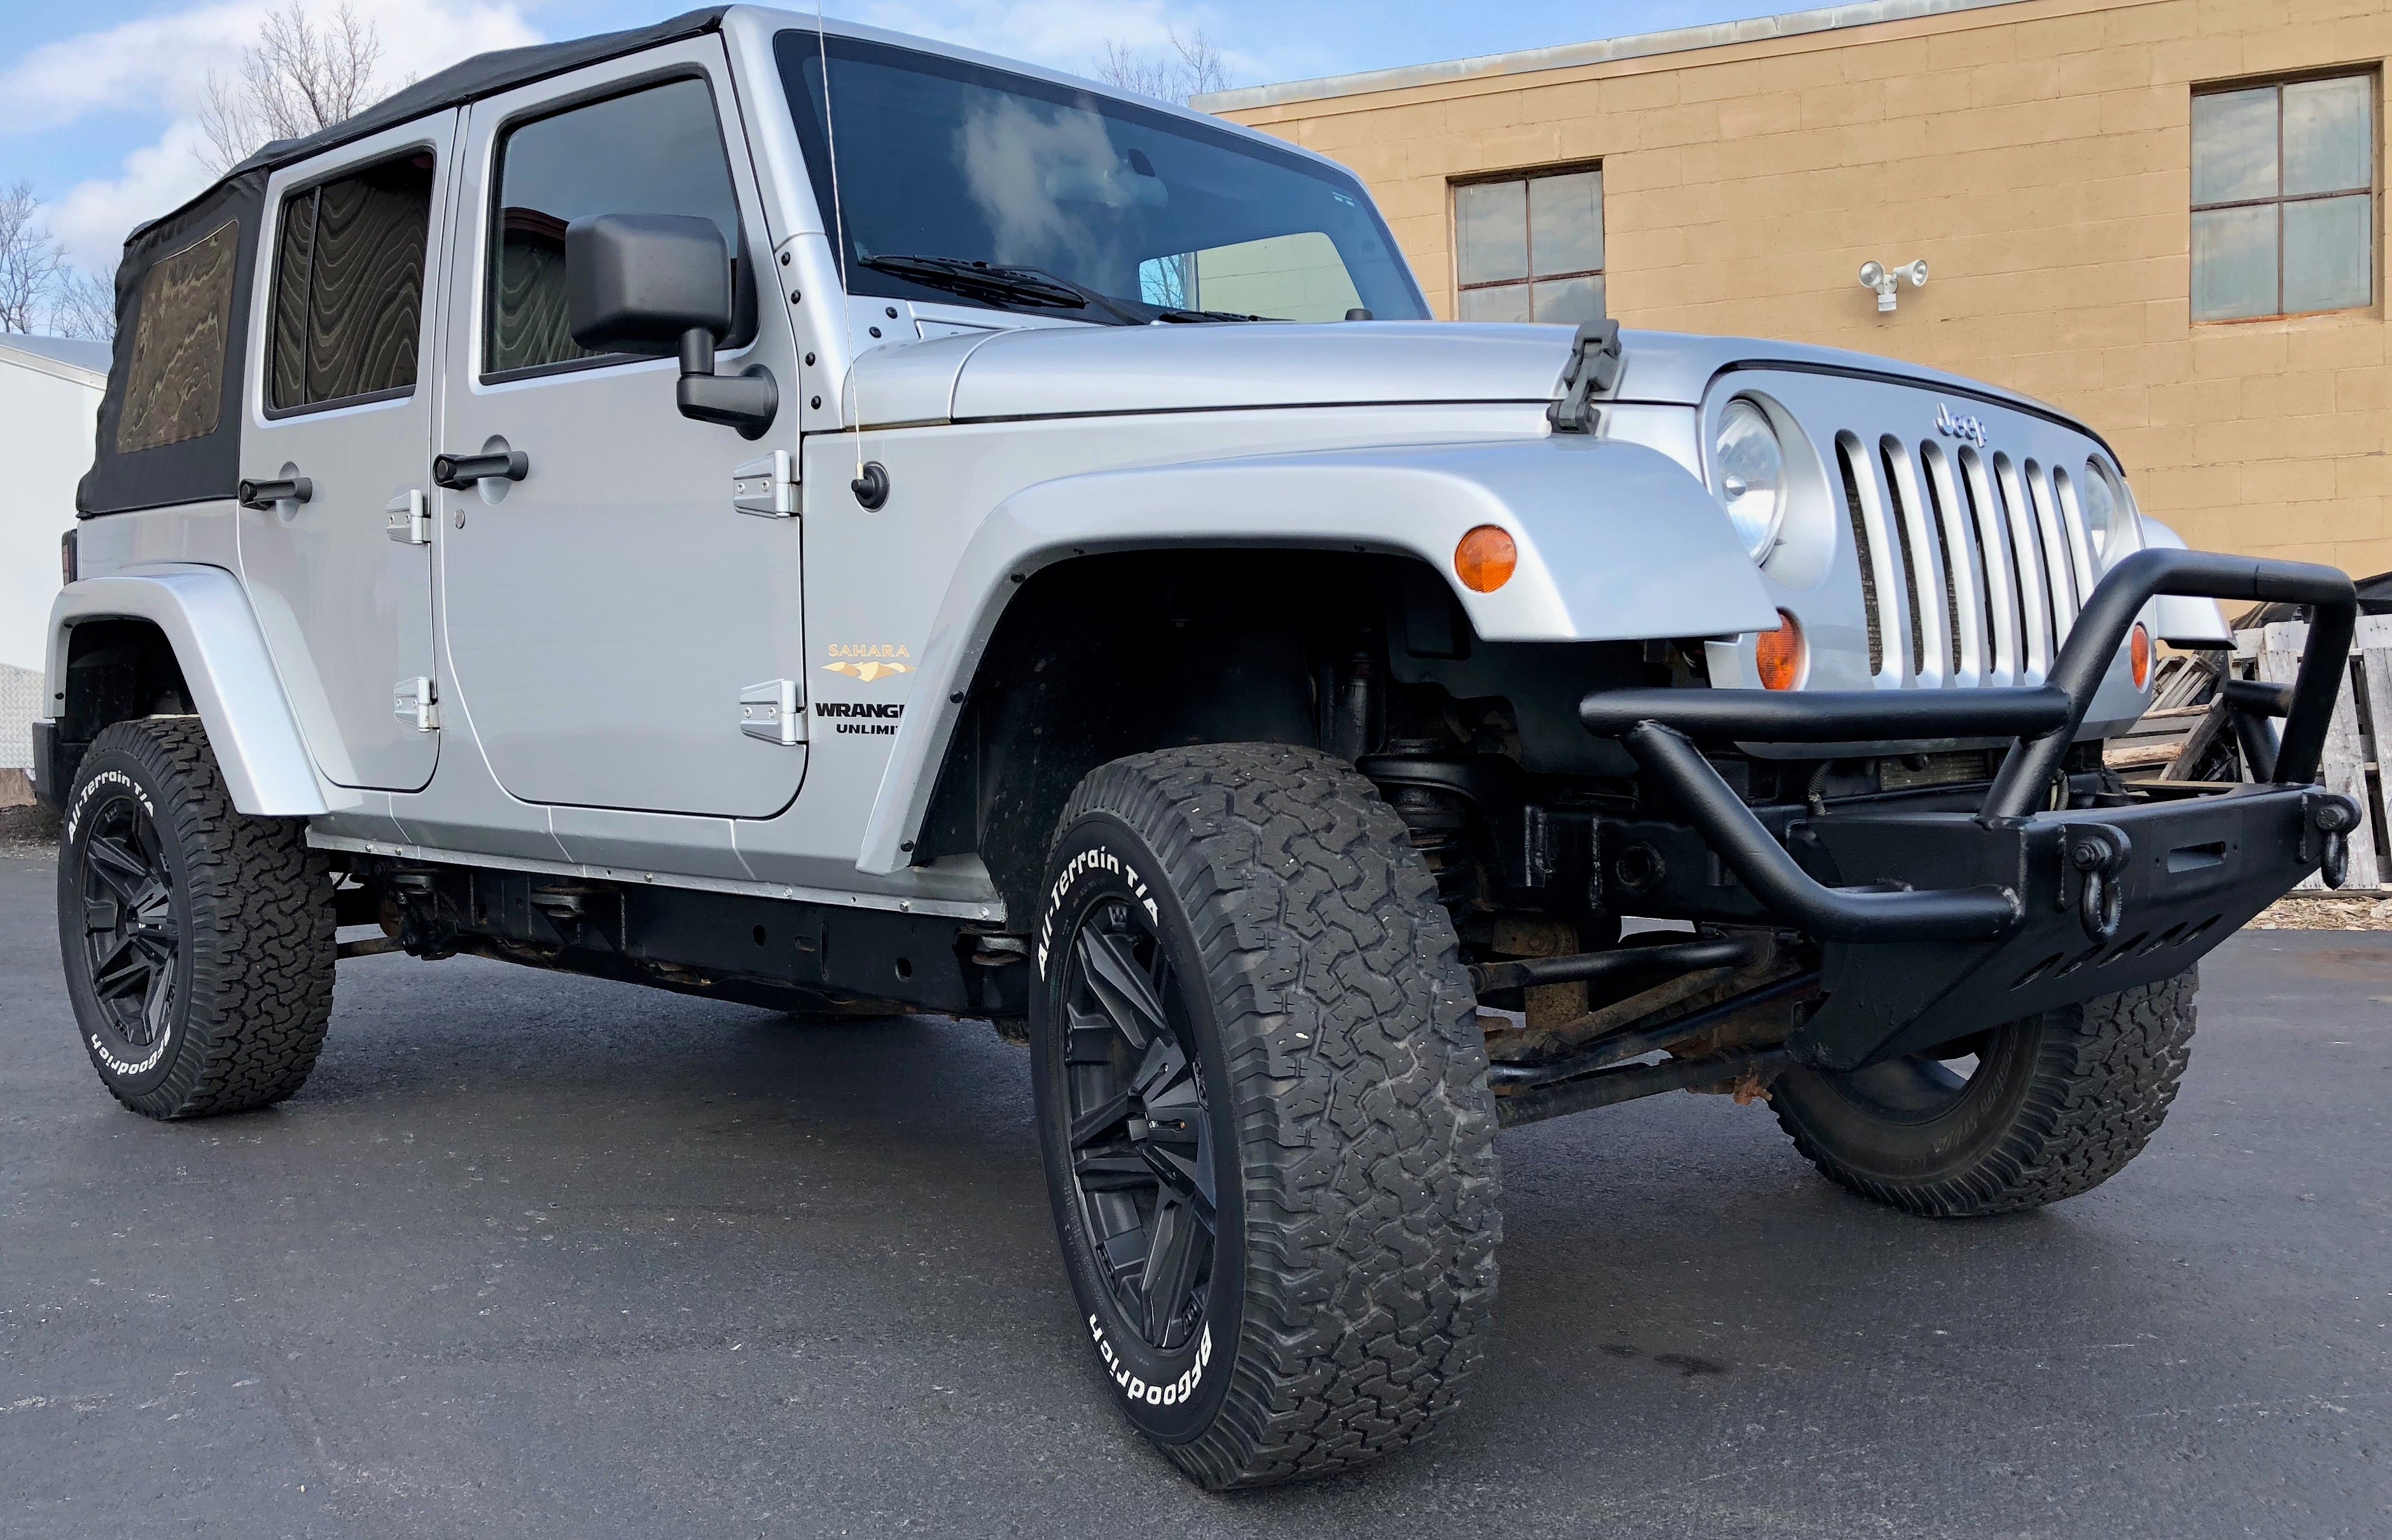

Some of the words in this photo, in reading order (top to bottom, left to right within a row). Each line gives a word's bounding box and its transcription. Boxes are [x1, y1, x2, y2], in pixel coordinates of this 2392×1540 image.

[1935, 402, 1988, 448] Jeep
[828, 643, 910, 658] SAHARA
[836, 723, 898, 735] UNLIMI
[68, 770, 130, 844] All-Terrain
[1038, 845, 1120, 982] All-Terrain
[91, 1022, 171, 1076] BFGoodrich
[1088, 1313, 1212, 1406] BFGoodrich
